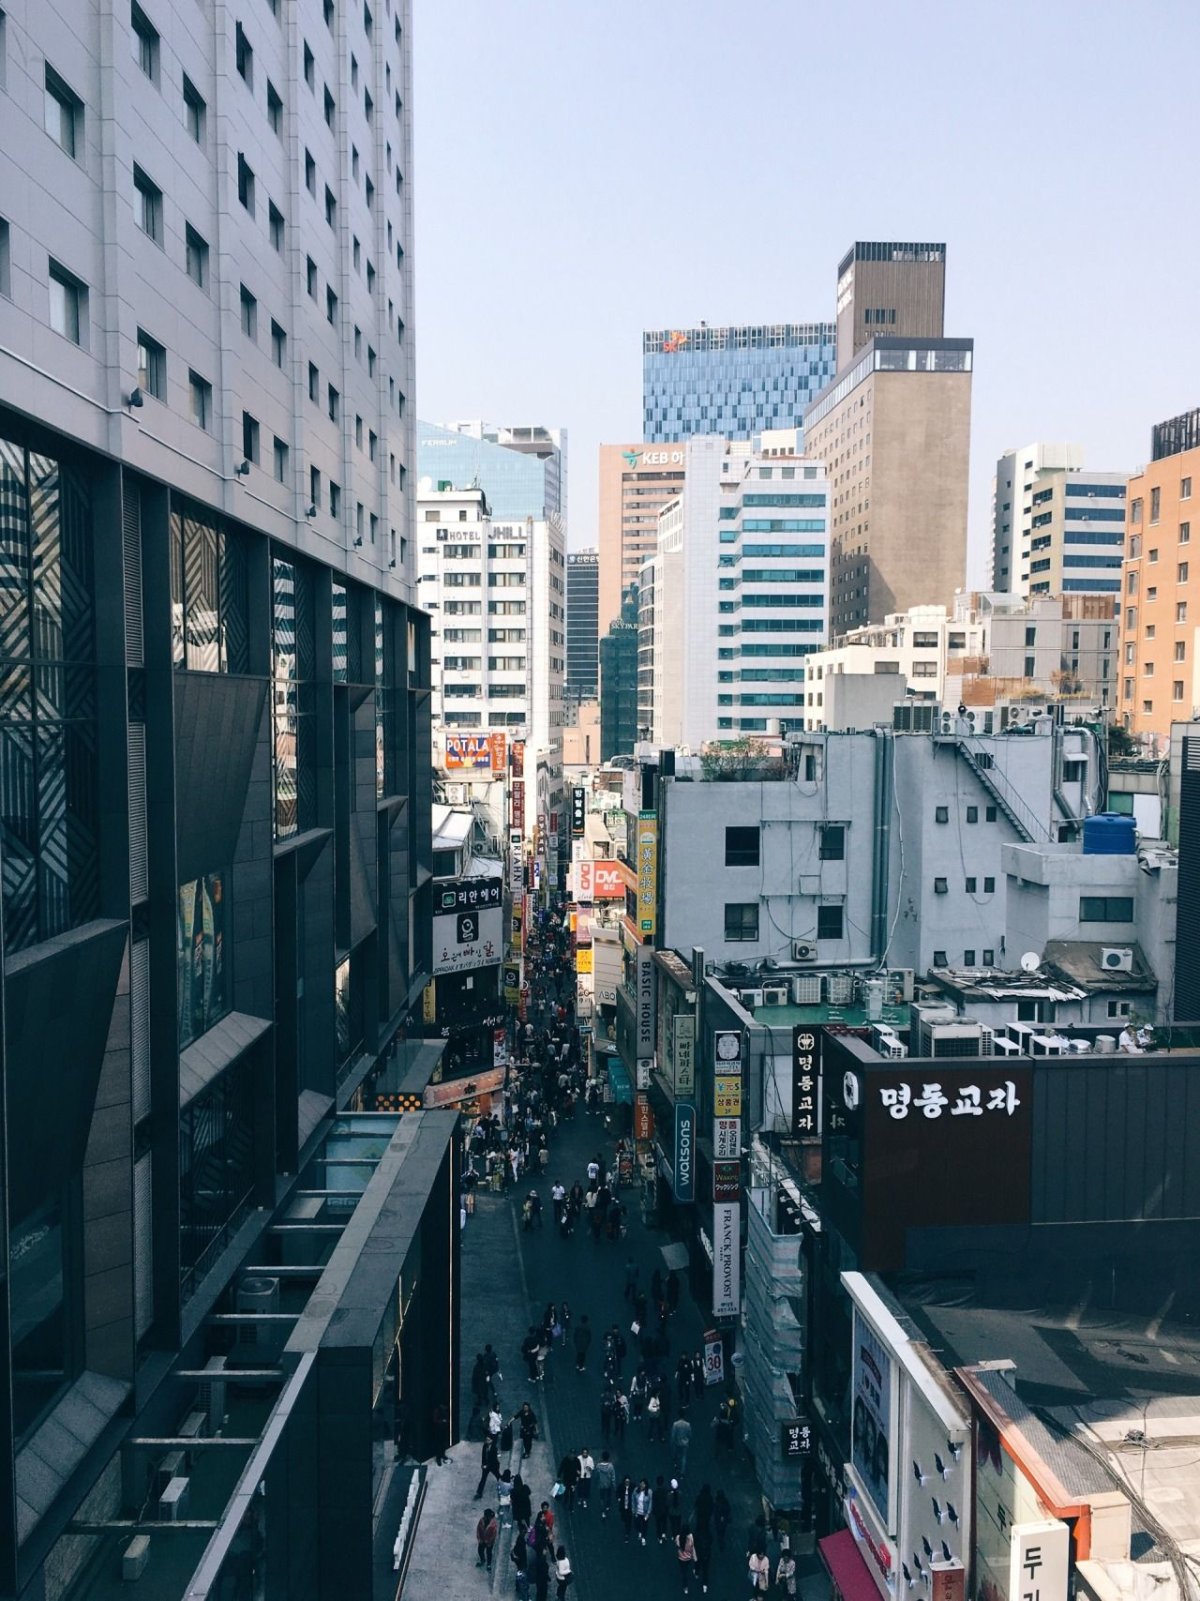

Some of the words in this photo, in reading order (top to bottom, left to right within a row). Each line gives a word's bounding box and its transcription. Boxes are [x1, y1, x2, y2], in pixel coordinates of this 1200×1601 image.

[643, 452, 668, 465] KEB
[449, 531, 480, 540] HOTEL
[488, 526, 528, 540] JHILL
[446, 739, 489, 752] POTALA
[513, 845, 522, 882] RIAHN
[641, 961, 651, 997] BASIC
[641, 1003, 651, 1043] HOUSE
[797, 1055, 814, 1130] 명동교자
[879, 1080, 1021, 1120] 명동교자
[680, 1119, 691, 1187] watsons
[723, 1209, 732, 1253] FRANCK
[723, 1253, 732, 1298] PROVOST
[788, 1426, 811, 1438] 명동
[788, 1438, 811, 1451] 교자
